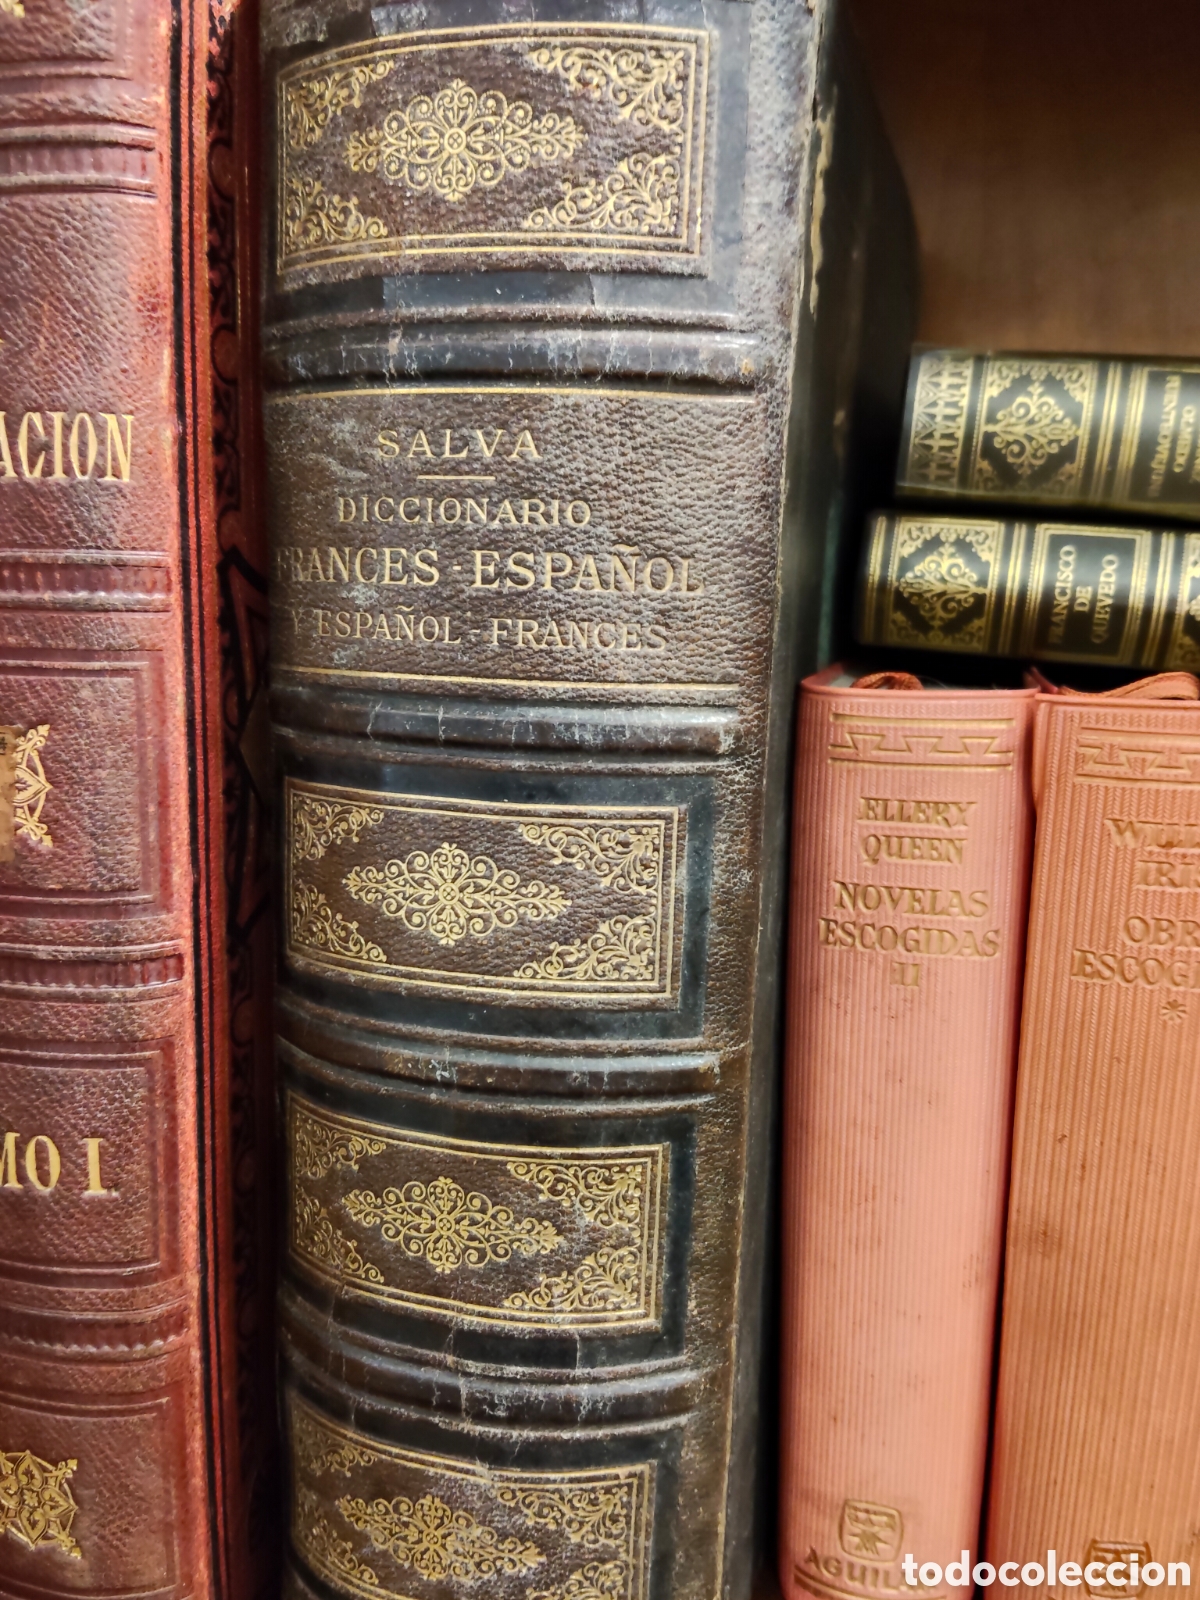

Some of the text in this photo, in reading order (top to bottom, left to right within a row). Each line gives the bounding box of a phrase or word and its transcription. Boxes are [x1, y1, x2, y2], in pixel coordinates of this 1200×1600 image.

[377, 429, 543, 460] SALVA
[337, 497, 592, 528] DICCIONARIO
[1073, 585, 1092, 612] DE
[1090, 554, 1120, 644] QUEVEDO
[858, 796, 978, 828] ELLERY
[863, 833, 968, 866] QUEEN
[832, 880, 990, 920] NOVELAS
[819, 916, 1000, 957] ESCOGIDAS
[803, 1545, 937, 1592] AGUIL
